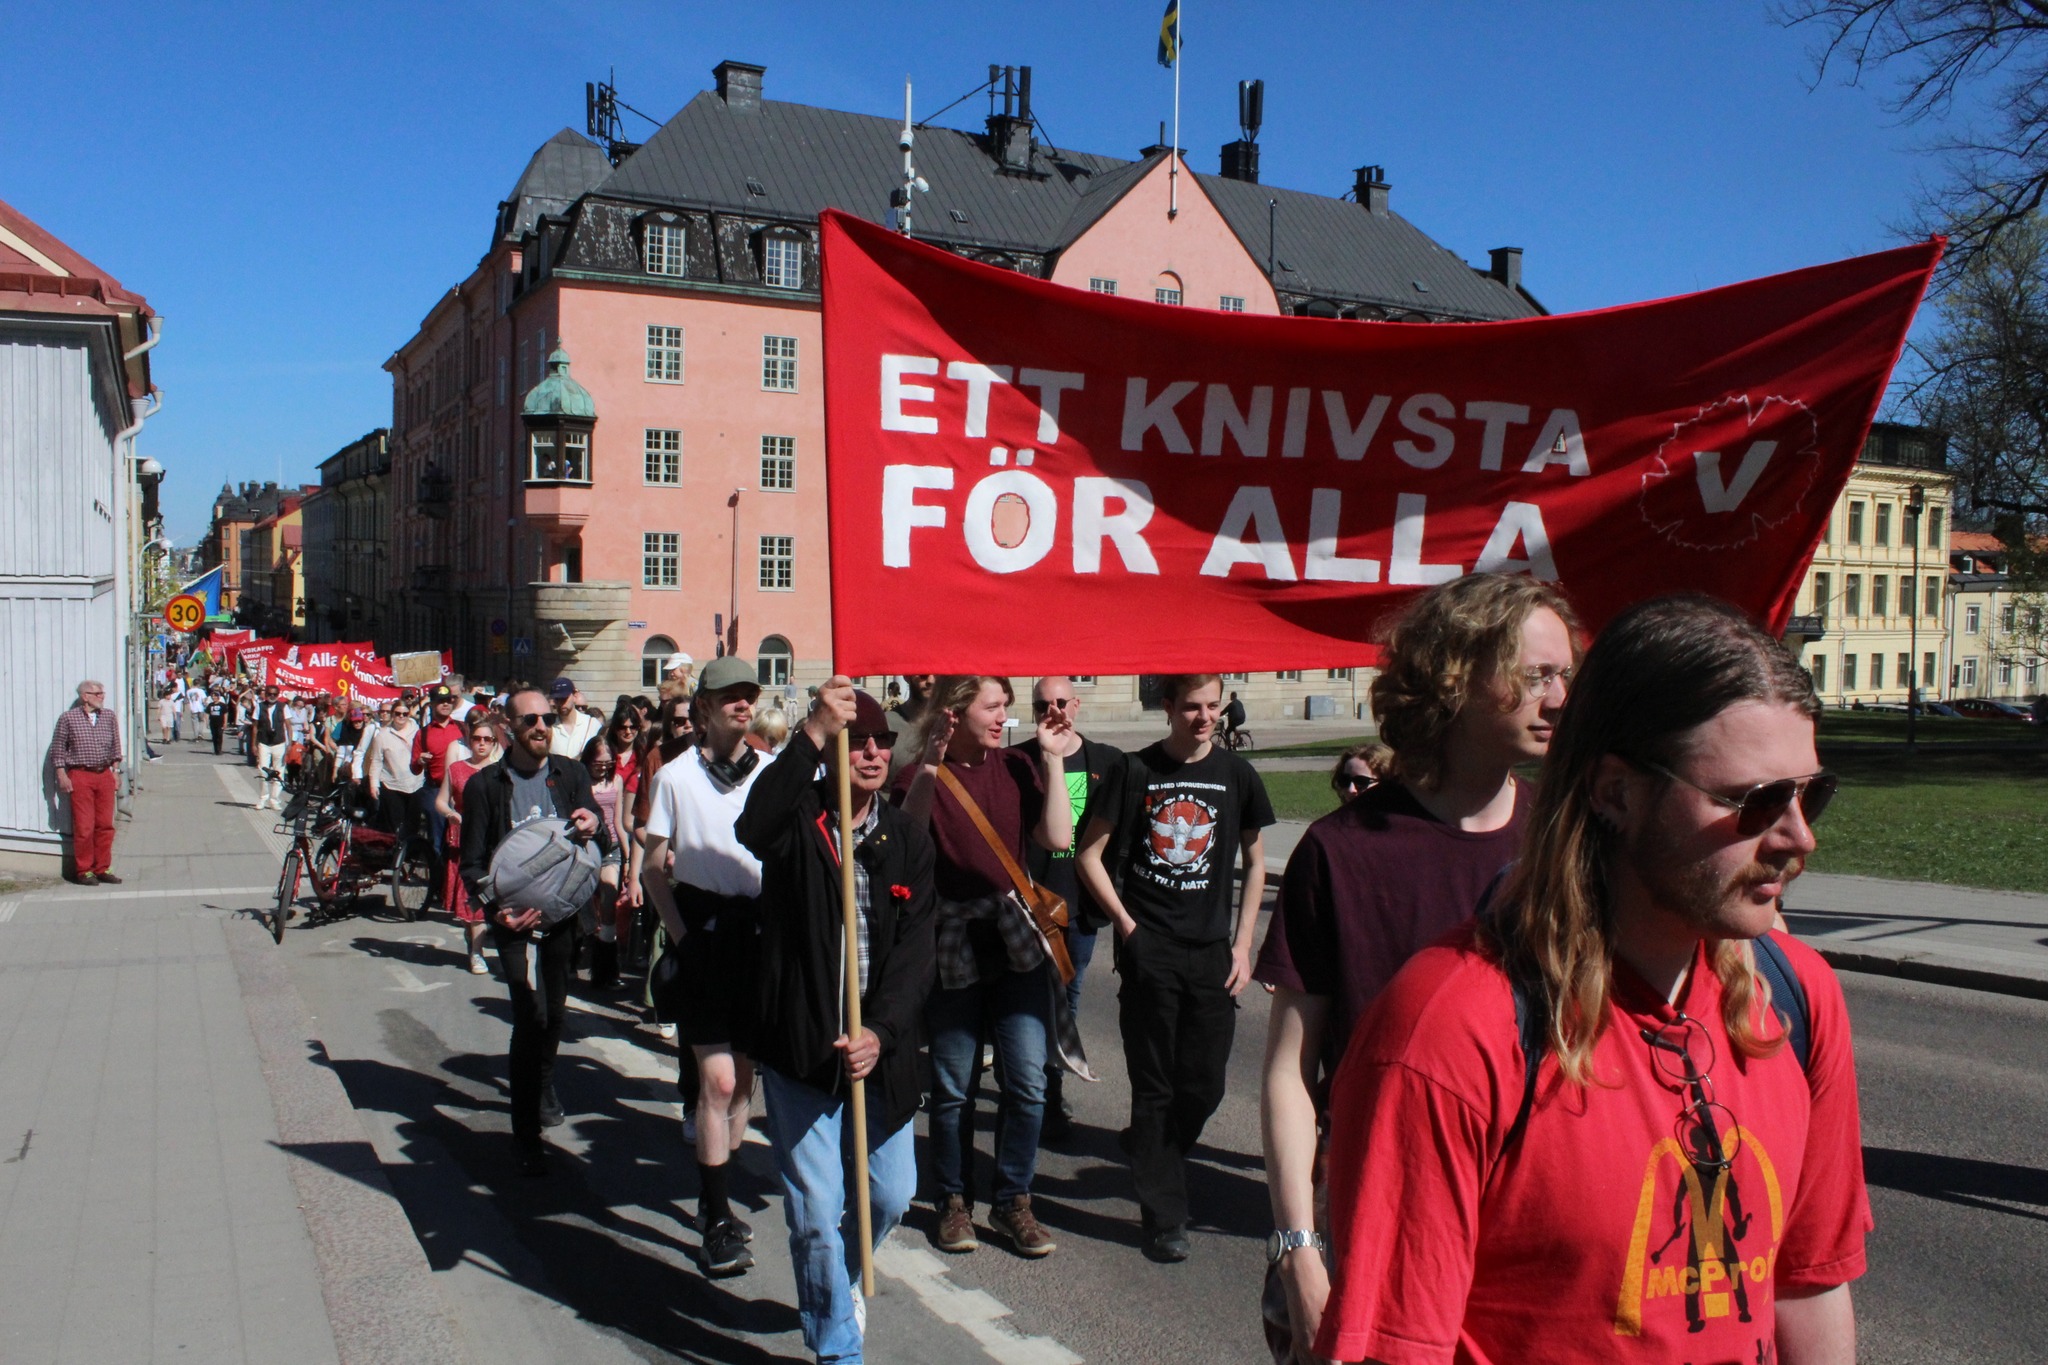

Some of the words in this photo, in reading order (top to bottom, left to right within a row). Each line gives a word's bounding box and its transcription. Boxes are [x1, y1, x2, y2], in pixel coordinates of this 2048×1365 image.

[881, 354, 1085, 445] ETT
[1121, 377, 1591, 476] KNIVSTA
[1693, 440, 1779, 513] V
[882, 446, 1160, 575] FÖR
[1200, 486, 1560, 586] ALLA
[172, 604, 199, 622] 30
[341, 655, 351, 672] 6
[337, 679, 348, 696] 9
[1155, 874, 1177, 888] TILL
